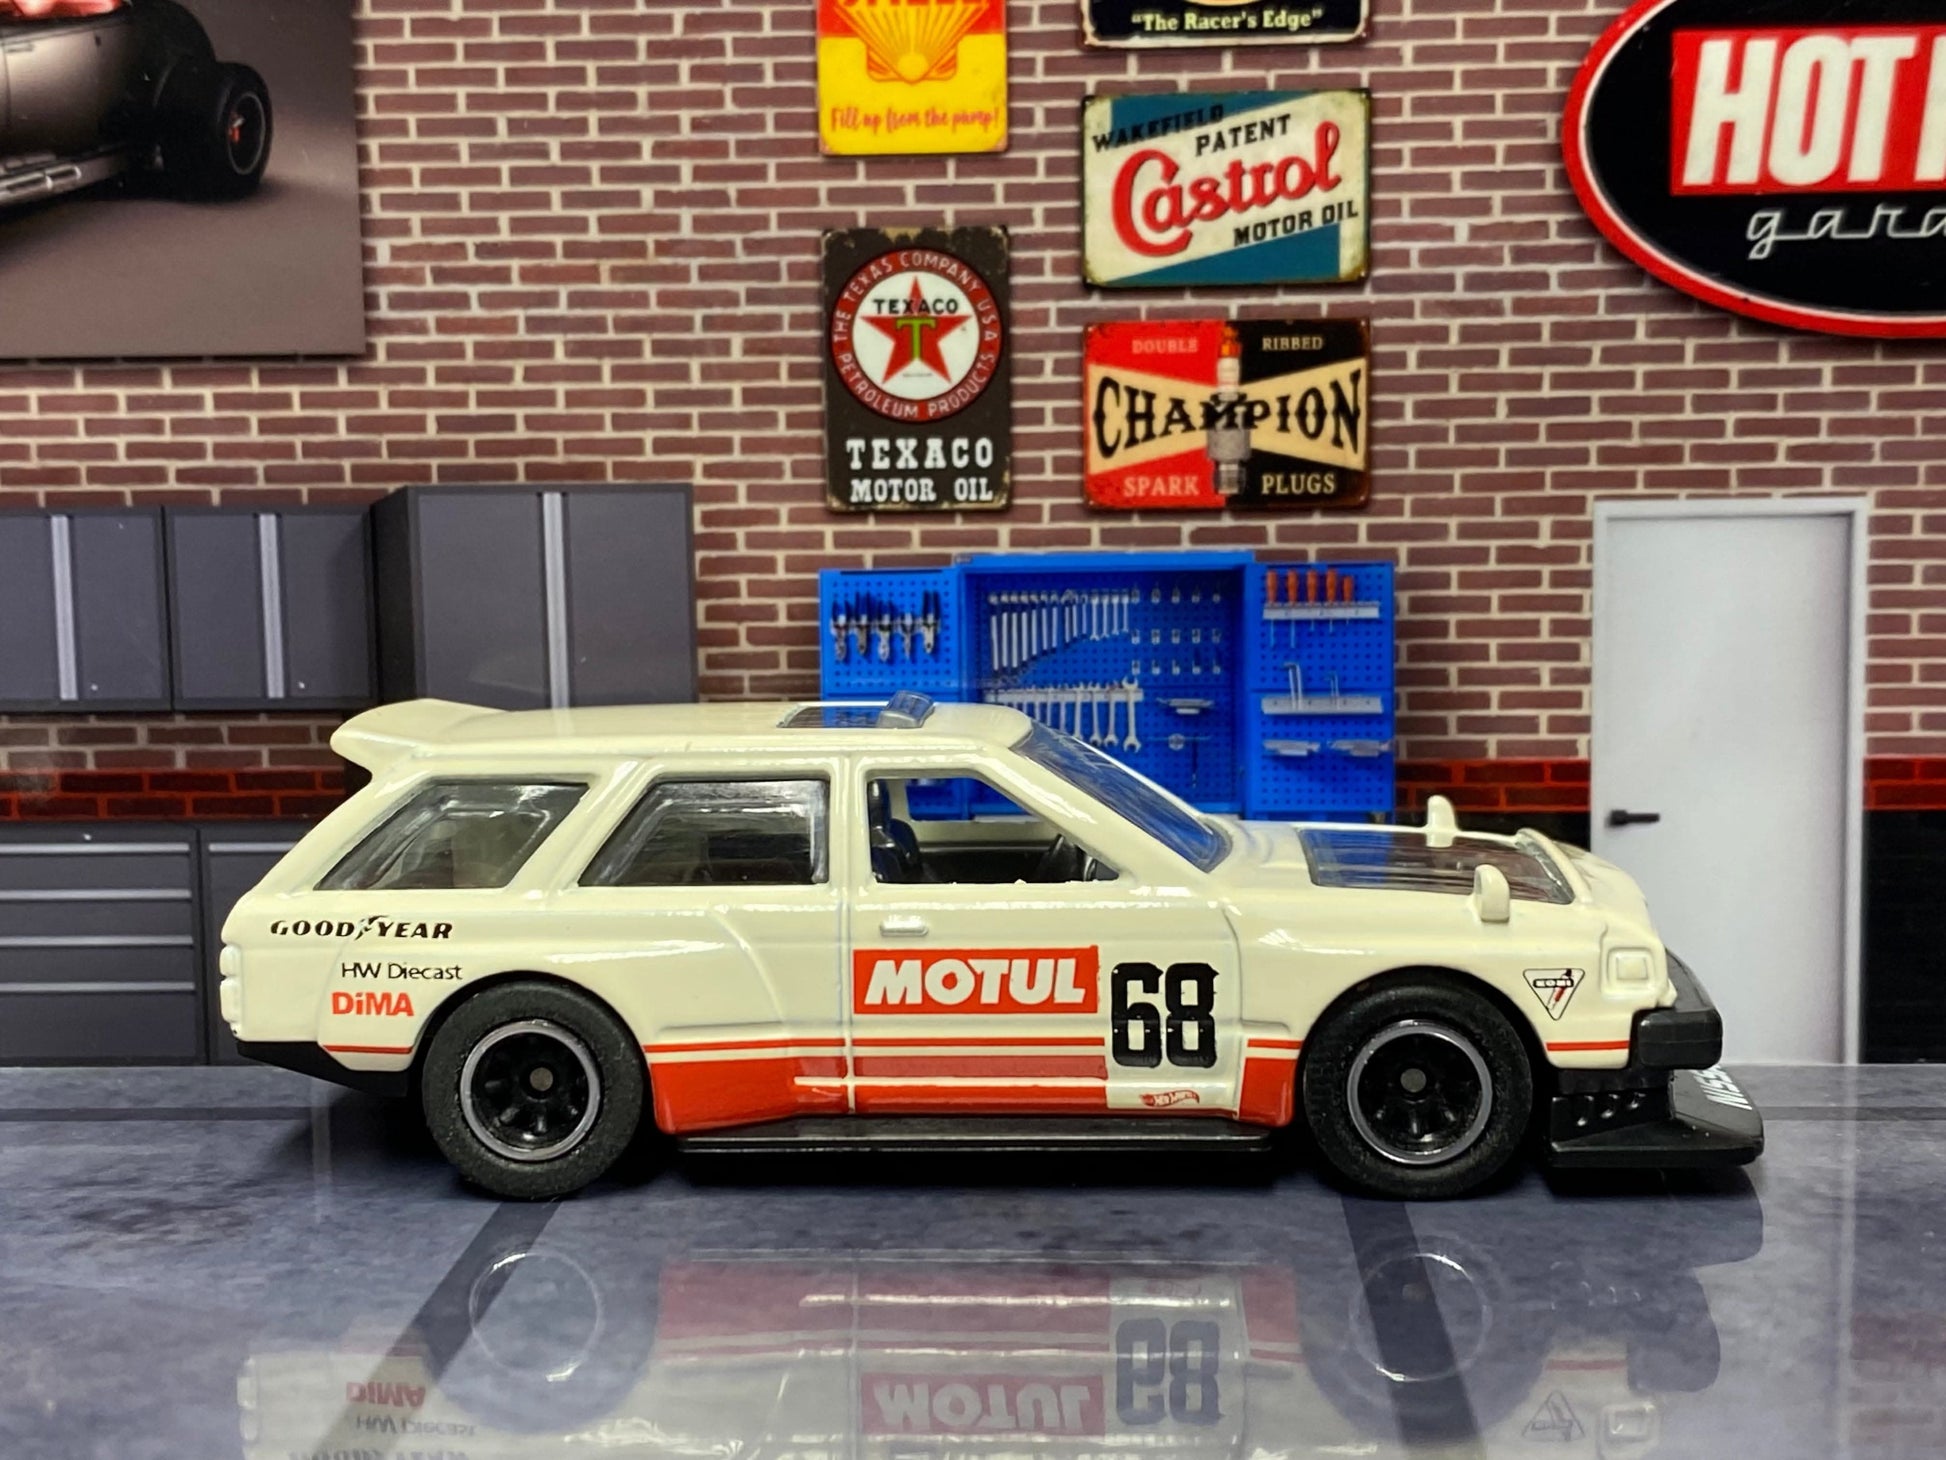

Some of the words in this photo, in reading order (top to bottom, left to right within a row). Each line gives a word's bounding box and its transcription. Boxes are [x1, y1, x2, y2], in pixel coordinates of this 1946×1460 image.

[1184, 11, 1257, 30] Racer's
[831, 106, 859, 132] Fill
[863, 113, 881, 135] up
[886, 107, 919, 133] from
[925, 106, 948, 127] the
[952, 106, 999, 133] pump!
[1092, 104, 1224, 152] WAKEFIELD
[1682, 34, 1918, 187] HOT
[1195, 113, 1291, 157] PATENT
[1111, 120, 1342, 258] Castrol
[1233, 209, 1313, 247] MOTOR
[1321, 199, 1359, 225] OIL
[833, 310, 851, 342] THE
[843, 257, 893, 302] TEXAS
[900, 252, 981, 292] COMPANY
[873, 298, 958, 315] TEXACO
[1132, 338, 1197, 354] DOUBLE
[1262, 336, 1323, 351] RIBBED
[838, 353, 918, 417] PETROLEUM
[928, 353, 995, 416] PRODUCTS
[1093, 368, 1361, 459] CHAMPION
[846, 437, 993, 470] TEXACO
[851, 477, 937, 502] MOTOR
[954, 476, 993, 501] OIL
[1123, 475, 1199, 497] SPARK
[1261, 473, 1335, 495] PLUGS
[341, 962, 381, 979] HW
[388, 962, 464, 981] Diecast
[864, 958, 1086, 1006] MOTUL
[332, 991, 414, 1017] DiMA
[1111, 962, 1220, 1068] 68
